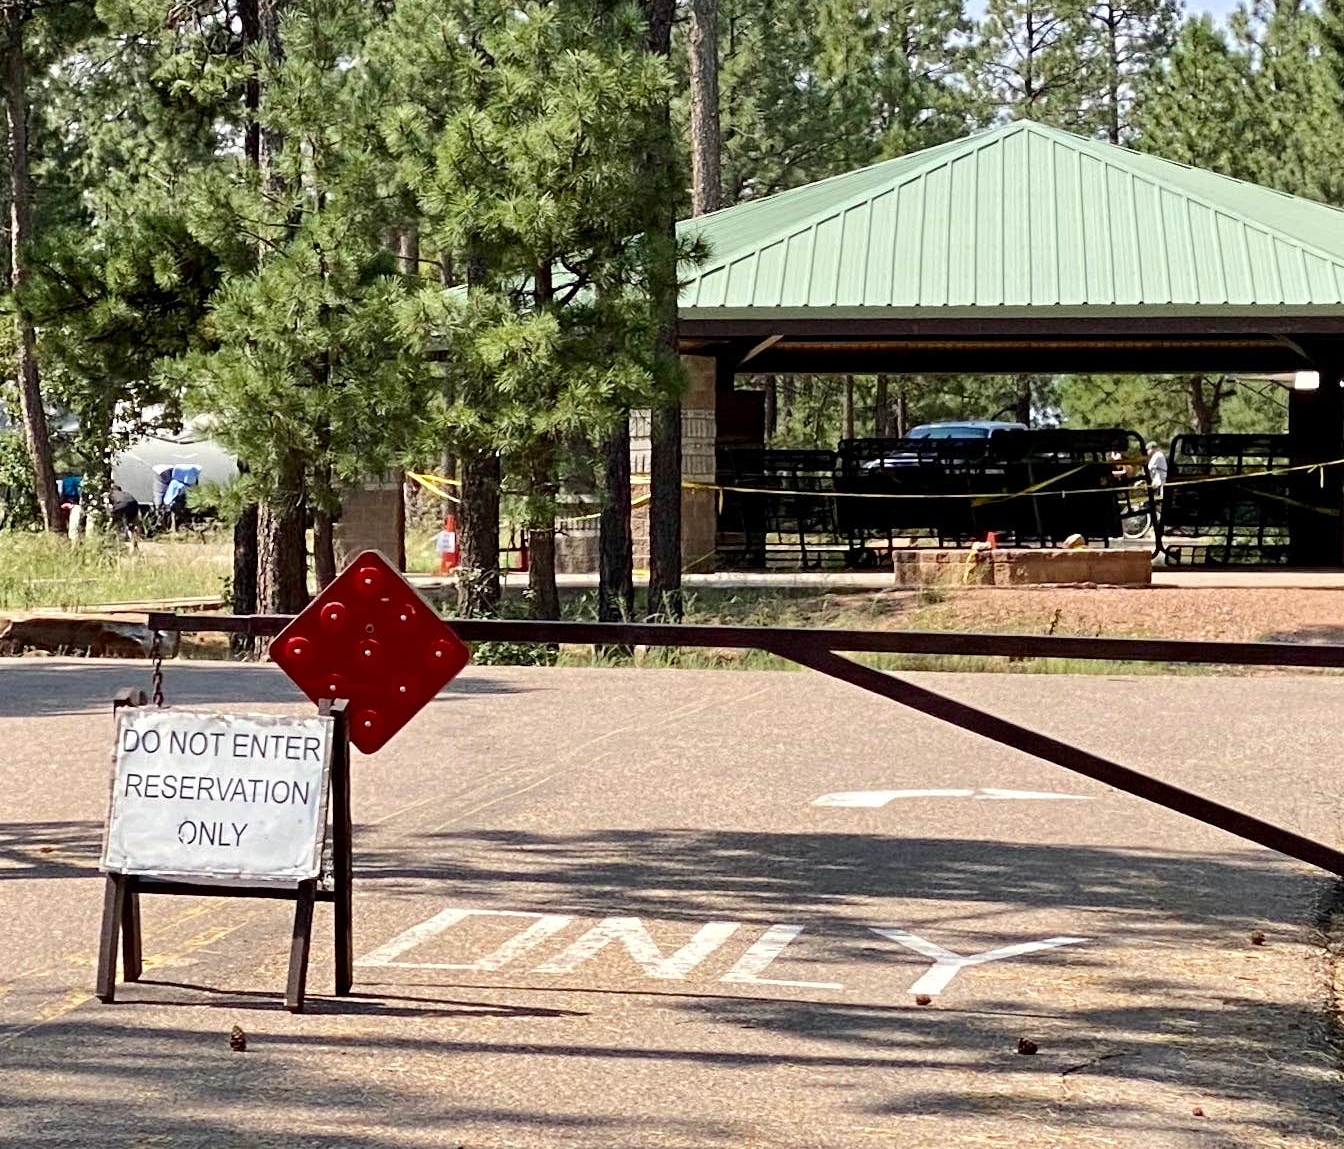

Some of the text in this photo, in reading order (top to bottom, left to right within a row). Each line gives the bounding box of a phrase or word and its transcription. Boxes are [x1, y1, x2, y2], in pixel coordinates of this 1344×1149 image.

[124, 729, 320, 761] DO NOT ENTER
[125, 774, 309, 804] RESERVATION
[178, 821, 248, 847] ONLY
[354, 908, 1090, 994] ONLY
